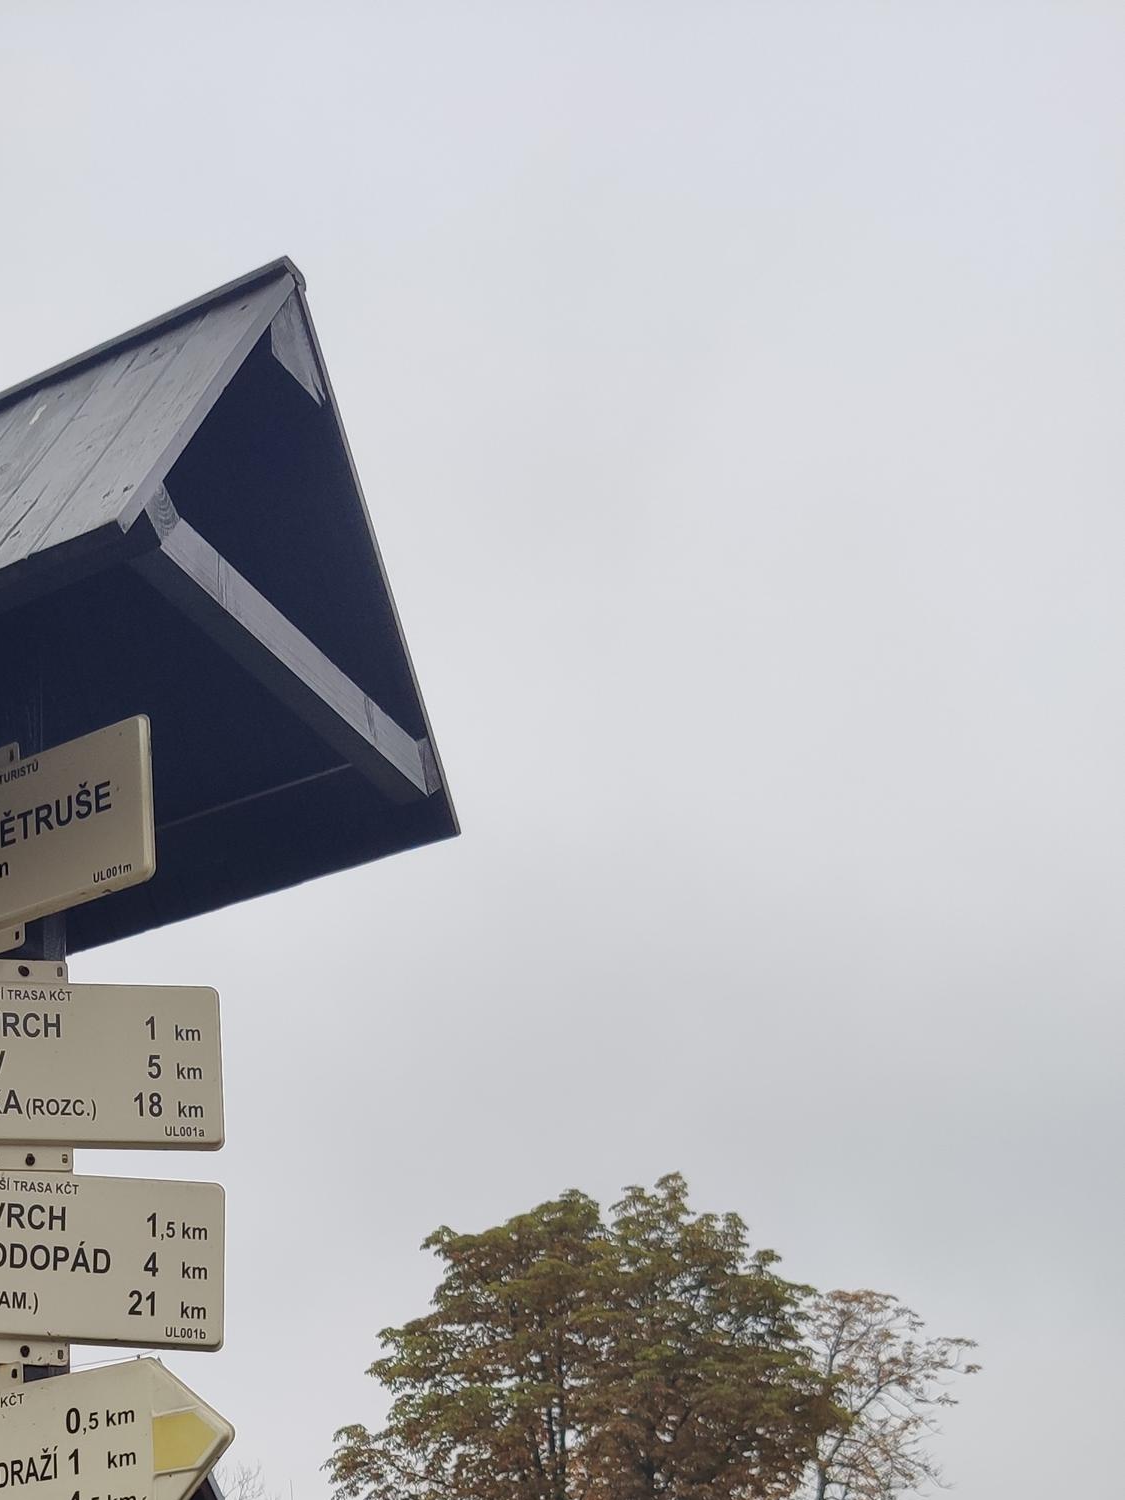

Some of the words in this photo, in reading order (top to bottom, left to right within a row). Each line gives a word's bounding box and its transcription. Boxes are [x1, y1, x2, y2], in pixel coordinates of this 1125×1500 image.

[93, 862, 132, 884] UL001m
[7, 989, 48, 1001] TRASA
[49, 987, 72, 1002] KČT
[145, 1015, 157, 1041] 1
[175, 1025, 202, 1042] km
[147, 1054, 163, 1080] 5
[176, 1062, 203, 1080] km
[133, 1092, 164, 1118] 18
[178, 1101, 204, 1119] km
[164, 1126, 205, 1138] UL001a
[13, 1180, 53, 1194] TRASA
[55, 1180, 80, 1196] KČT
[146, 1212, 176, 1240] 1,5
[182, 1222, 208, 1241] km
[143, 1252, 159, 1277] 4
[181, 1262, 208, 1280] km
[127, 1290, 158, 1317] 21
[180, 1302, 207, 1320] km
[165, 1326, 207, 1341] UL001b
[0, 1392, 25, 1410] KČT
[65, 1407, 99, 1436] 0,5
[105, 1407, 135, 1428] km
[67, 1449, 81, 1476] 1
[107, 1450, 136, 1470] km
